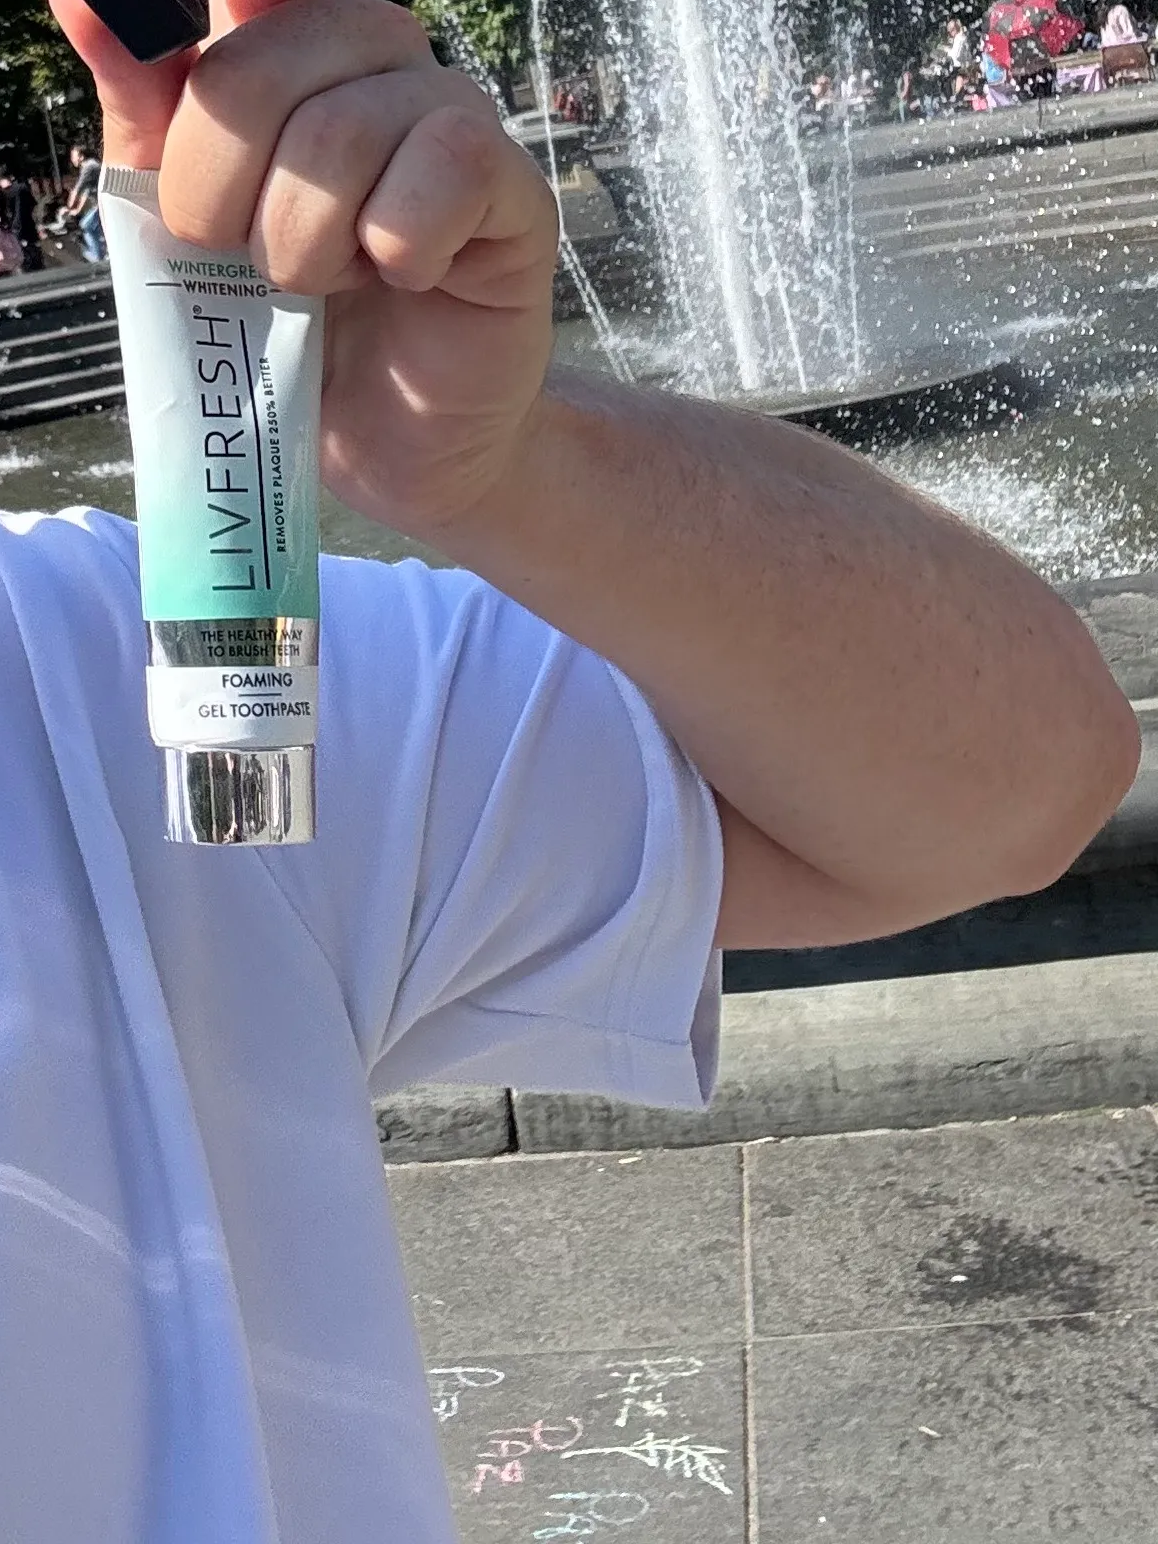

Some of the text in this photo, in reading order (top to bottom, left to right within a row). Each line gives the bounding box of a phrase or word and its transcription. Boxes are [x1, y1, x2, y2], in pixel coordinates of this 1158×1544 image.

[167, 259, 263, 279] WINTERGRE
[182, 279, 268, 298] WHITENING
[258, 357, 286, 552] REMOVES PLAQUE 250% BETTER
[201, 629, 303, 642] THE HEALTHY WAY
[207, 644, 300, 657] TO BRUSH TEETH
[221, 672, 293, 688] FOAMING
[198, 701, 311, 718] GEL TOOTHPASTE
